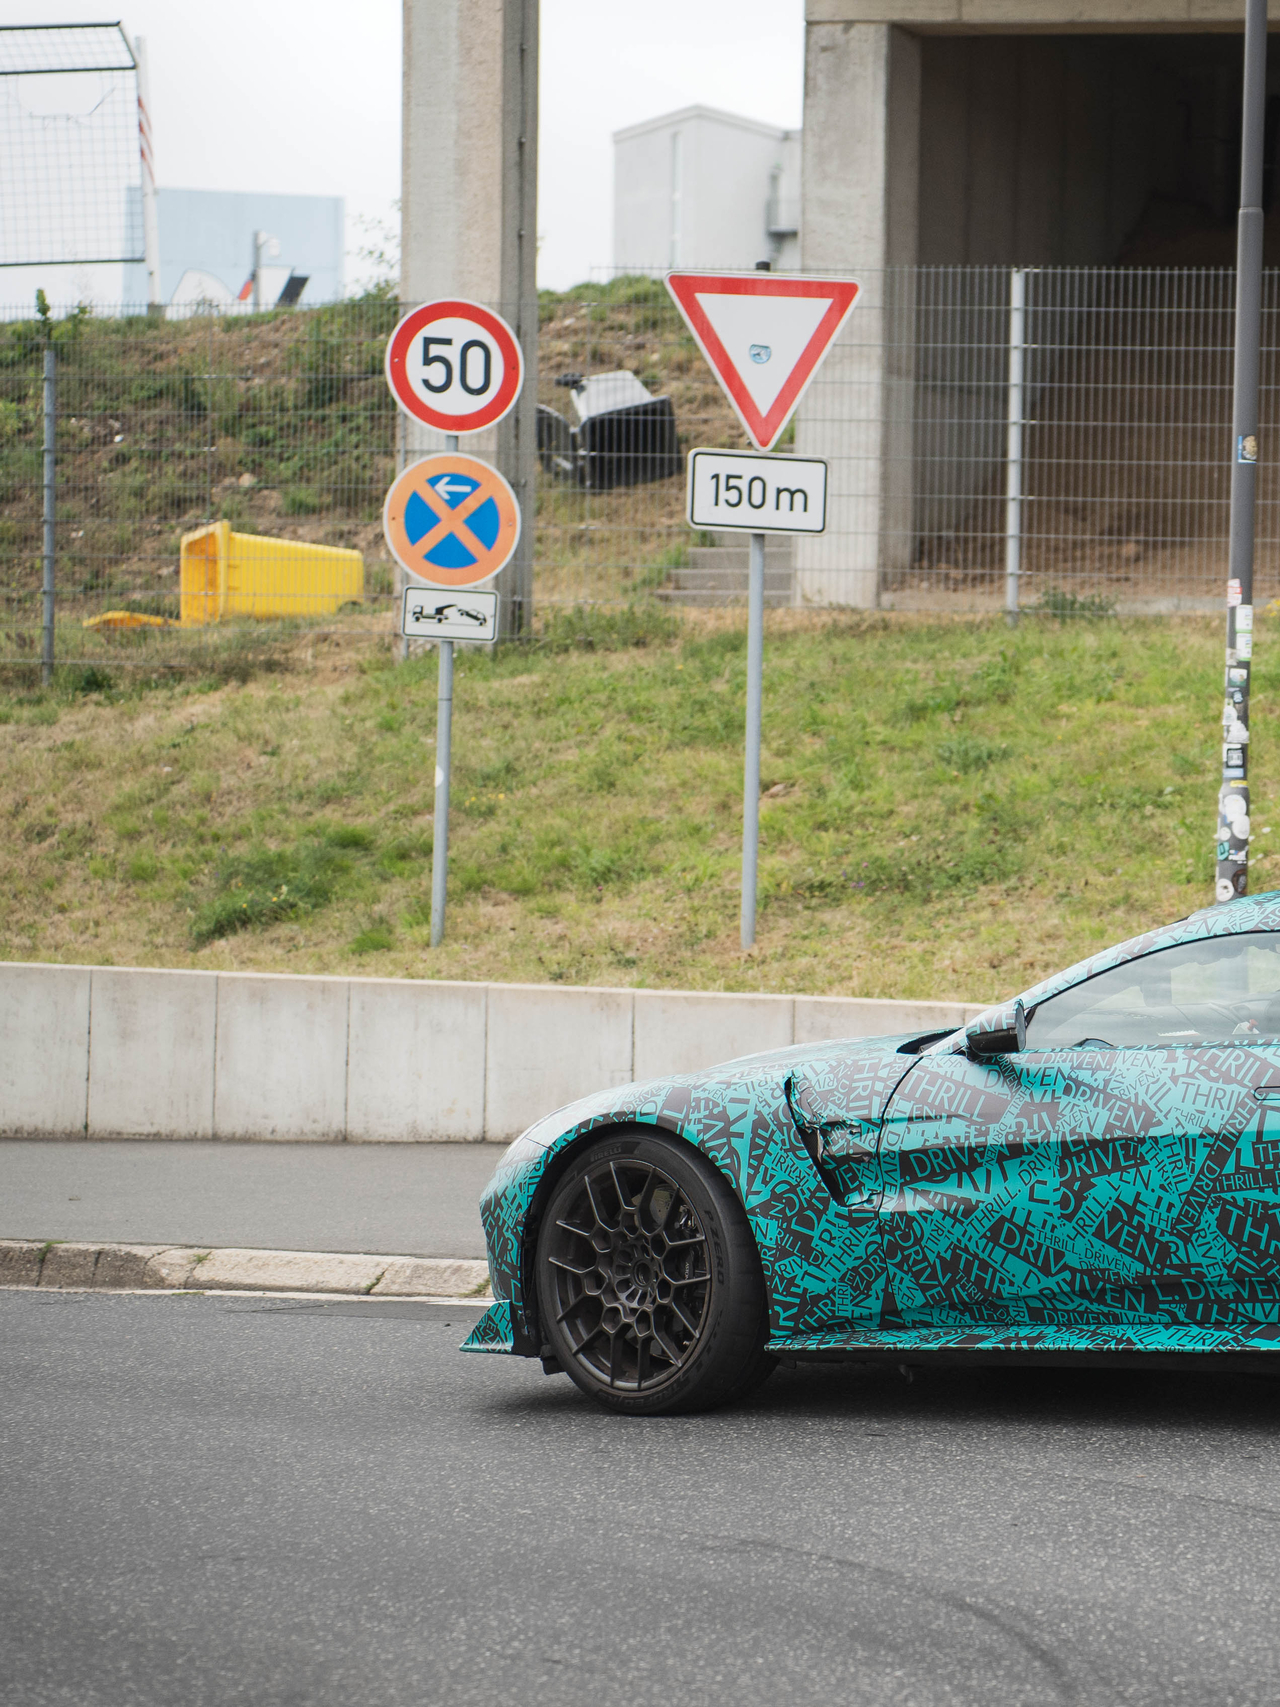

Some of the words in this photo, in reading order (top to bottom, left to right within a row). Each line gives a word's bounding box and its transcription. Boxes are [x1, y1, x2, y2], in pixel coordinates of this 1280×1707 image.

[421, 336, 492, 396] 50
[709, 473, 767, 510] 150
[775, 486, 808, 513] m
[903, 1069, 986, 1122] THRILL
[1061, 1079, 1146, 1137] DRIVEN.
[966, 1185, 1022, 1235] THRILL.
